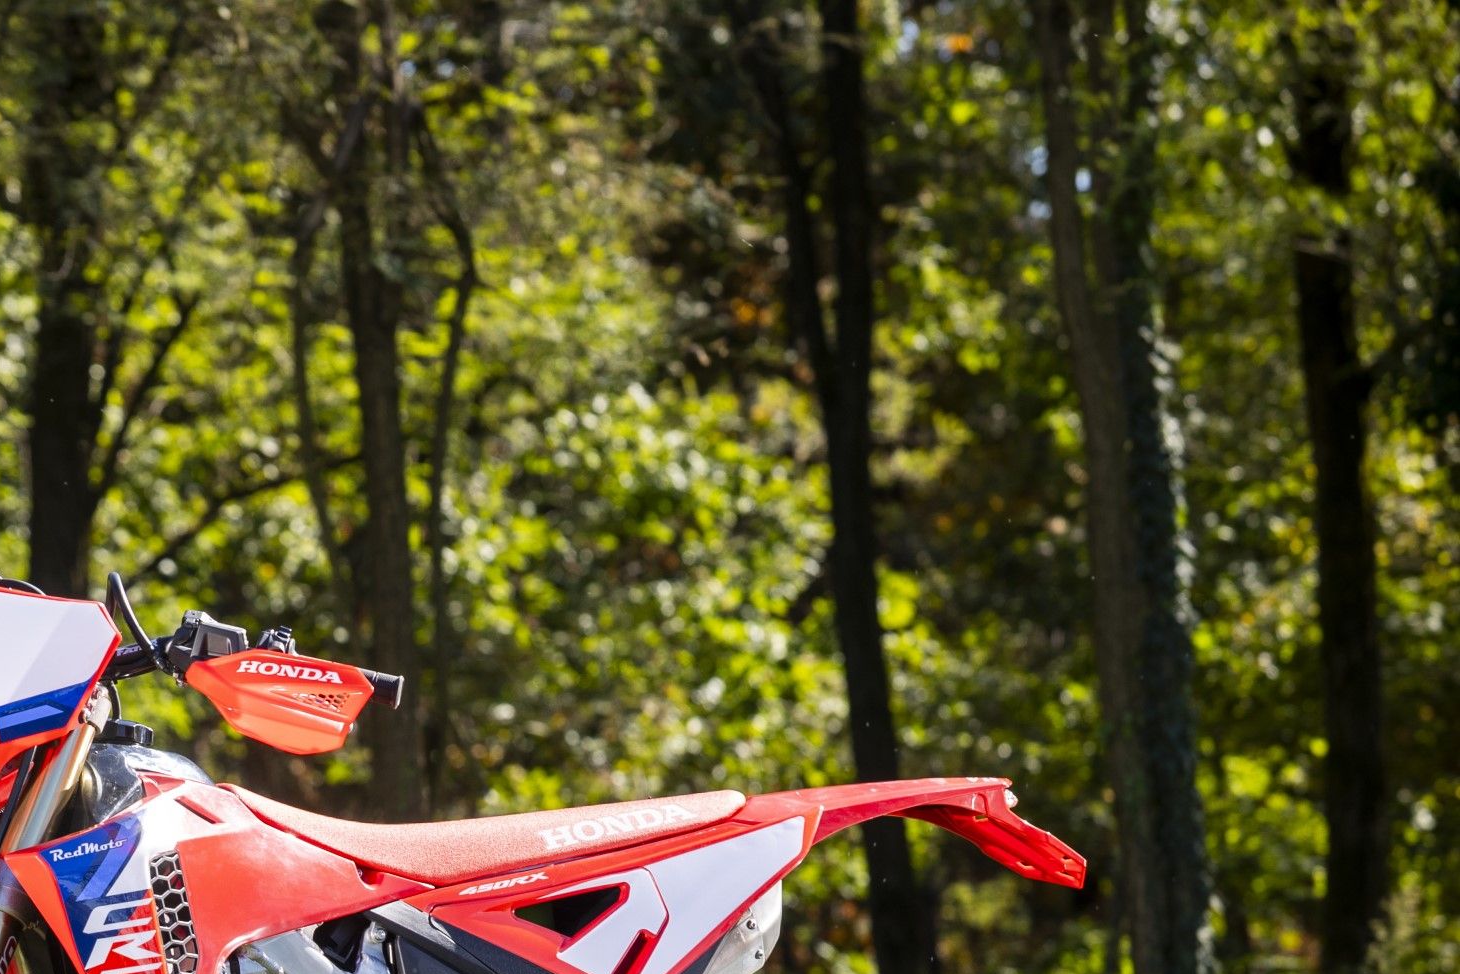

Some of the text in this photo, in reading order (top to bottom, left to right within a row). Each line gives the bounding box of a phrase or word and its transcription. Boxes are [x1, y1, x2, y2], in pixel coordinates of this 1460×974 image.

[236, 660, 343, 684] HONDA
[539, 804, 698, 850] HONDA
[50, 839, 127, 862] RedMoto
[458, 872, 549, 896] 450RX
